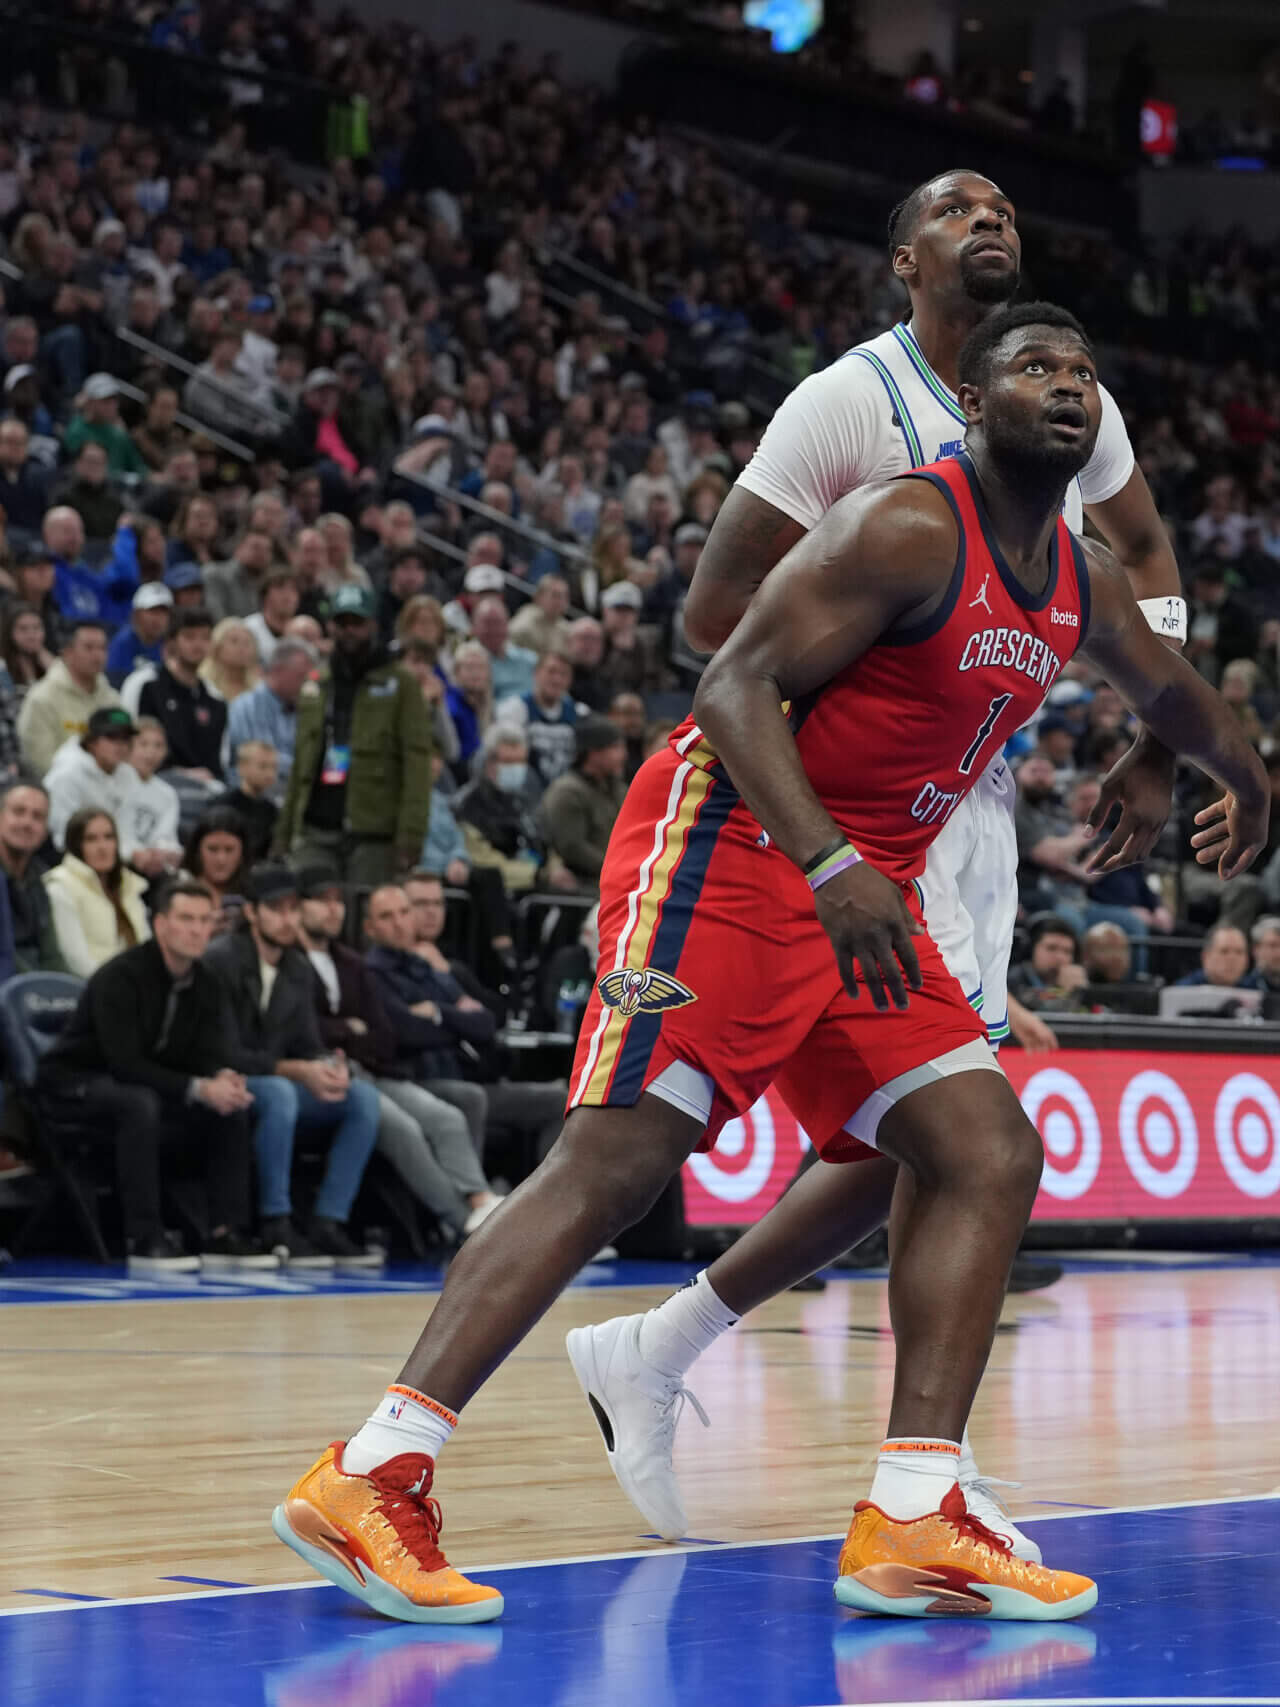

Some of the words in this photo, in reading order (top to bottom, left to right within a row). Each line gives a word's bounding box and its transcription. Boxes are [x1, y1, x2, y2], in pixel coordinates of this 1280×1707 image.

[939, 440, 962, 458] NIKE
[1050, 606, 1079, 627] ibotta
[1161, 617, 1179, 631] NR
[958, 627, 1061, 695] CRESCENT
[957, 692, 1014, 776] 1
[910, 781, 966, 825] CITY
